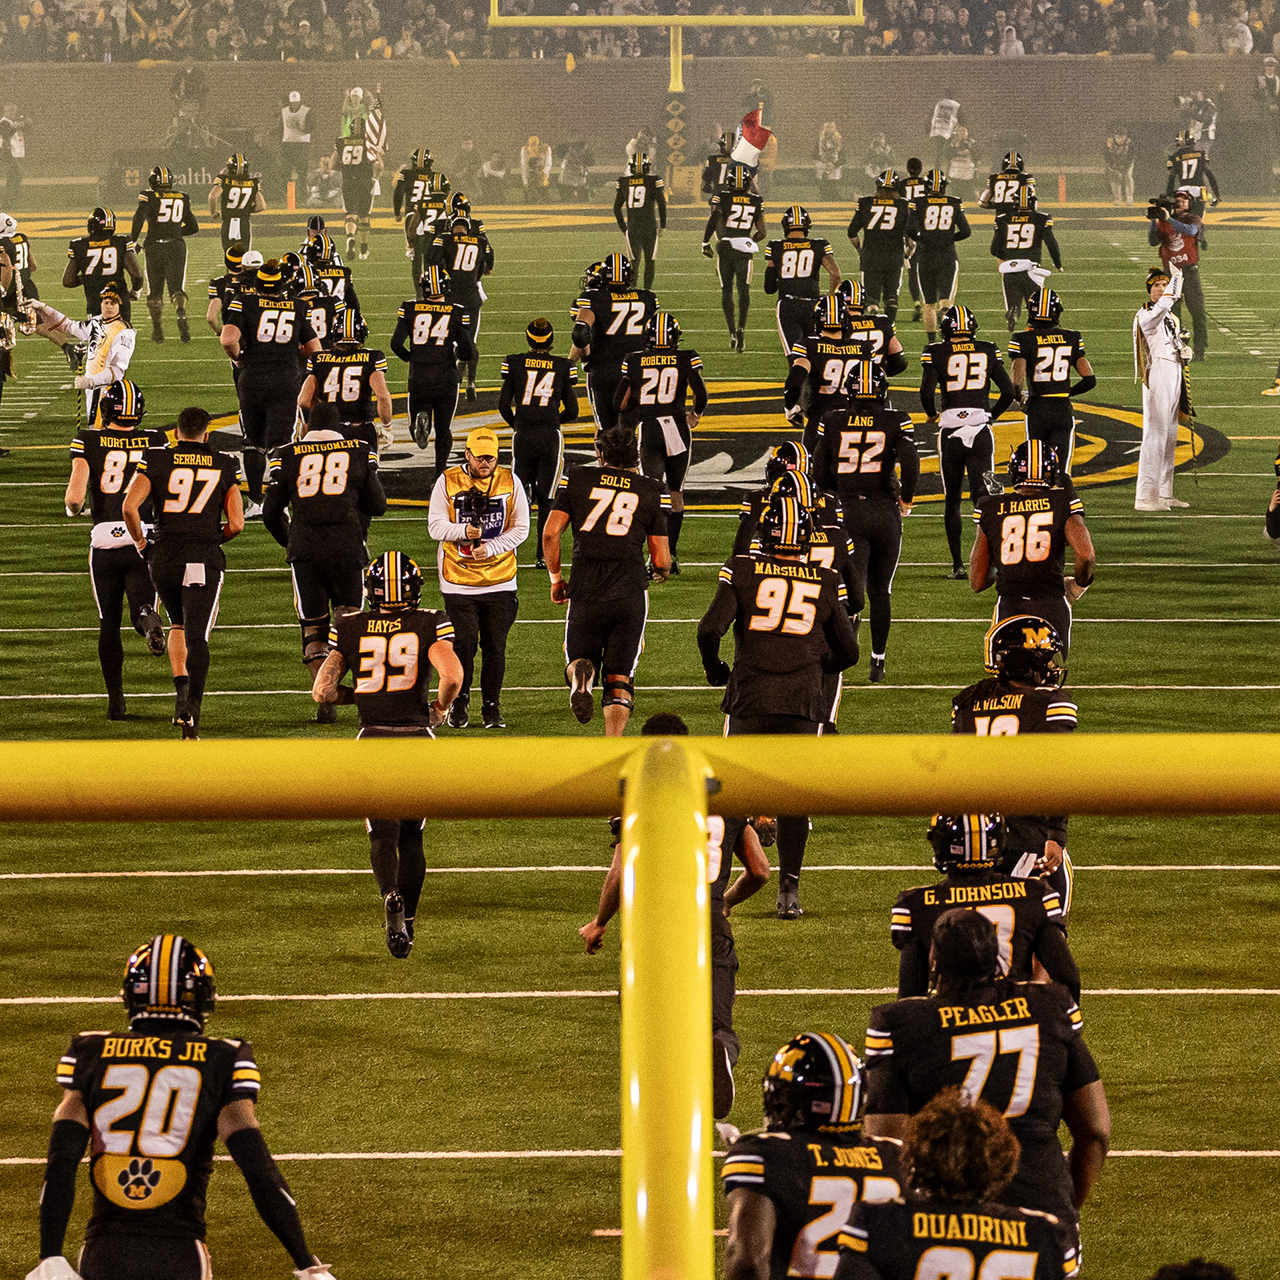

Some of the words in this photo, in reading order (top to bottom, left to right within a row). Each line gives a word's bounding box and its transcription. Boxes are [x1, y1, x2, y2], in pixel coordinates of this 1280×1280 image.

[342, 145, 363, 165] 69
[1182, 158, 1198, 179] 17
[226, 187, 252, 209] 97
[628, 186, 646, 208] 19
[994, 180, 1020, 203] 82
[157, 198, 184, 223] 50
[726, 205, 756, 230] 25
[867, 206, 898, 230] 73
[924, 205, 954, 231] 88
[1006, 224, 1035, 249] 59
[85, 247, 117, 275] 79
[452, 244, 478, 271] 10
[781, 250, 815, 279] 80
[257, 310, 296, 344] 66
[413, 313, 450, 346] 84
[606, 302, 645, 335] 72
[817, 343, 862, 355] FIRESTONE
[952, 343, 975, 352] BAUER
[1036, 335, 1067, 346] McNEIL
[317, 353, 370, 363] STRAATMANN
[525, 358, 553, 370] BROWN
[641, 355, 677, 366] ROBERTS
[1033, 345, 1072, 382] 26
[324, 366, 363, 403] 46
[947, 352, 988, 392] 93
[521, 370, 556, 407] 14
[640, 367, 678, 404] 20
[848, 416, 873, 426] LANG
[100, 436, 150, 448] NORFLEET
[293, 438, 361, 456] MONTGOMERY
[837, 431, 886, 474] 52
[173, 453, 213, 467] SERRANO
[297, 451, 350, 498] 88
[600, 474, 631, 489] SOLIS
[163, 467, 222, 514] 97
[580, 487, 639, 536] 78
[997, 502, 1007, 515] J.
[1010, 498, 1050, 513] HARRIS
[1000, 512, 1054, 565] 86
[755, 562, 821, 581] MARSHALL
[749, 577, 821, 635] 95
[367, 618, 402, 633] HAYES
[1022, 628, 1052, 649] M
[355, 632, 420, 694] 39
[983, 695, 1024, 711] WILSON
[924, 889, 940, 906] G.
[945, 882, 1026, 904] JOHNSON
[939, 998, 1031, 1028] PEAGLER
[101, 1037, 172, 1060] BURKS
[179, 1041, 207, 1062] JR
[951, 1024, 1040, 1119] 77
[93, 1064, 202, 1158] 20
[808, 1144, 828, 1167] T.
[833, 1146, 883, 1170] JONES
[913, 1213, 1028, 1246] QUADRINI
